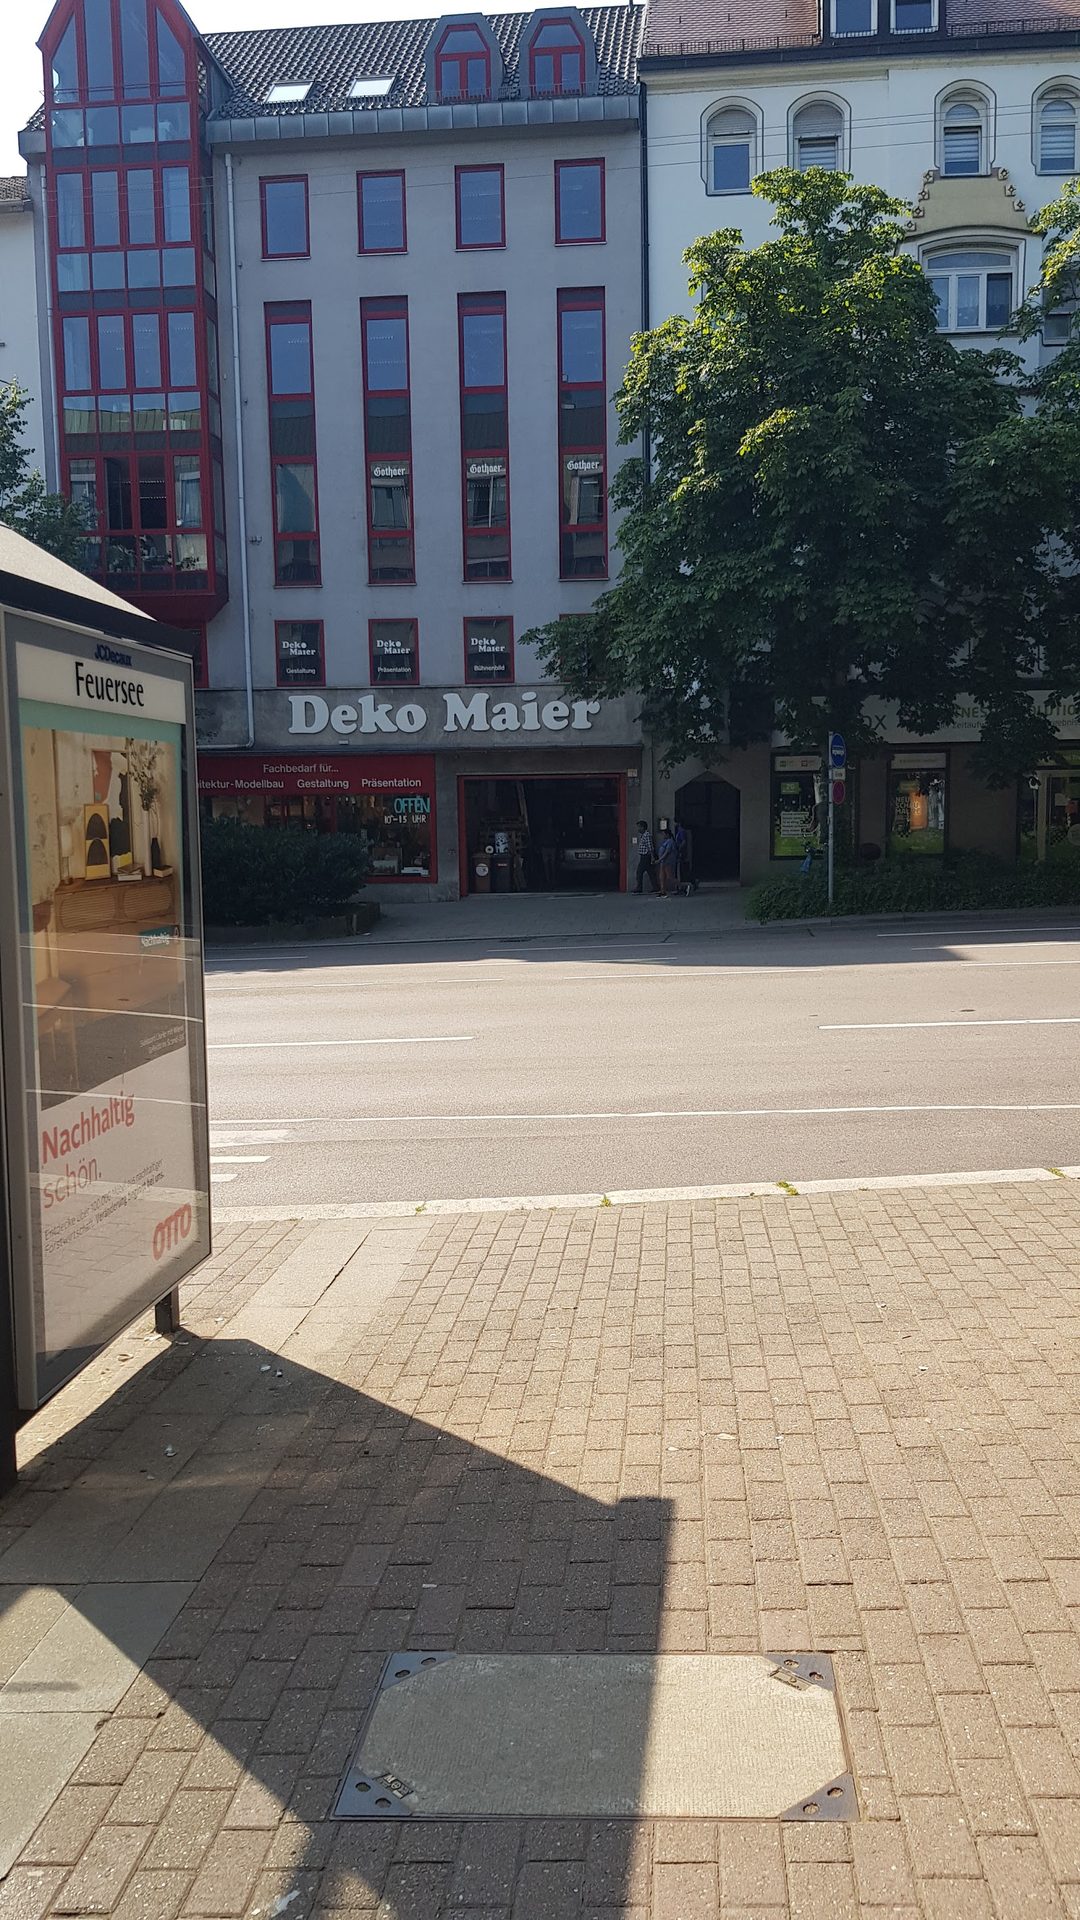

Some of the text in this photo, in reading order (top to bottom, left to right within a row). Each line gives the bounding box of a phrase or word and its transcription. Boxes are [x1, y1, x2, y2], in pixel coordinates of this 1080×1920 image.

[469, 464, 502, 475] Gothaer
[566, 460, 600, 471] Gothaer
[373, 466, 405, 478] Gothaer
[282, 641, 307, 649] Deko
[376, 639, 402, 647] Deko
[470, 637, 496, 646] Deko
[289, 648, 316, 656] Maier
[75, 661, 145, 707] Feuersee
[288, 691, 601, 734] Deko Maier
[263, 763, 317, 774] Fachbedarf
[658, 770, 671, 780] 73
[297, 779, 350, 791] Gestaltung
[360, 777, 422, 788] Präsentation
[394, 796, 431, 814] OFFEN
[411, 814, 428, 824] UHR
[41, 1090, 135, 1165] Nachhaltig
[43, 1157, 102, 1209] schön.
[152, 1202, 193, 1261] OTTO
